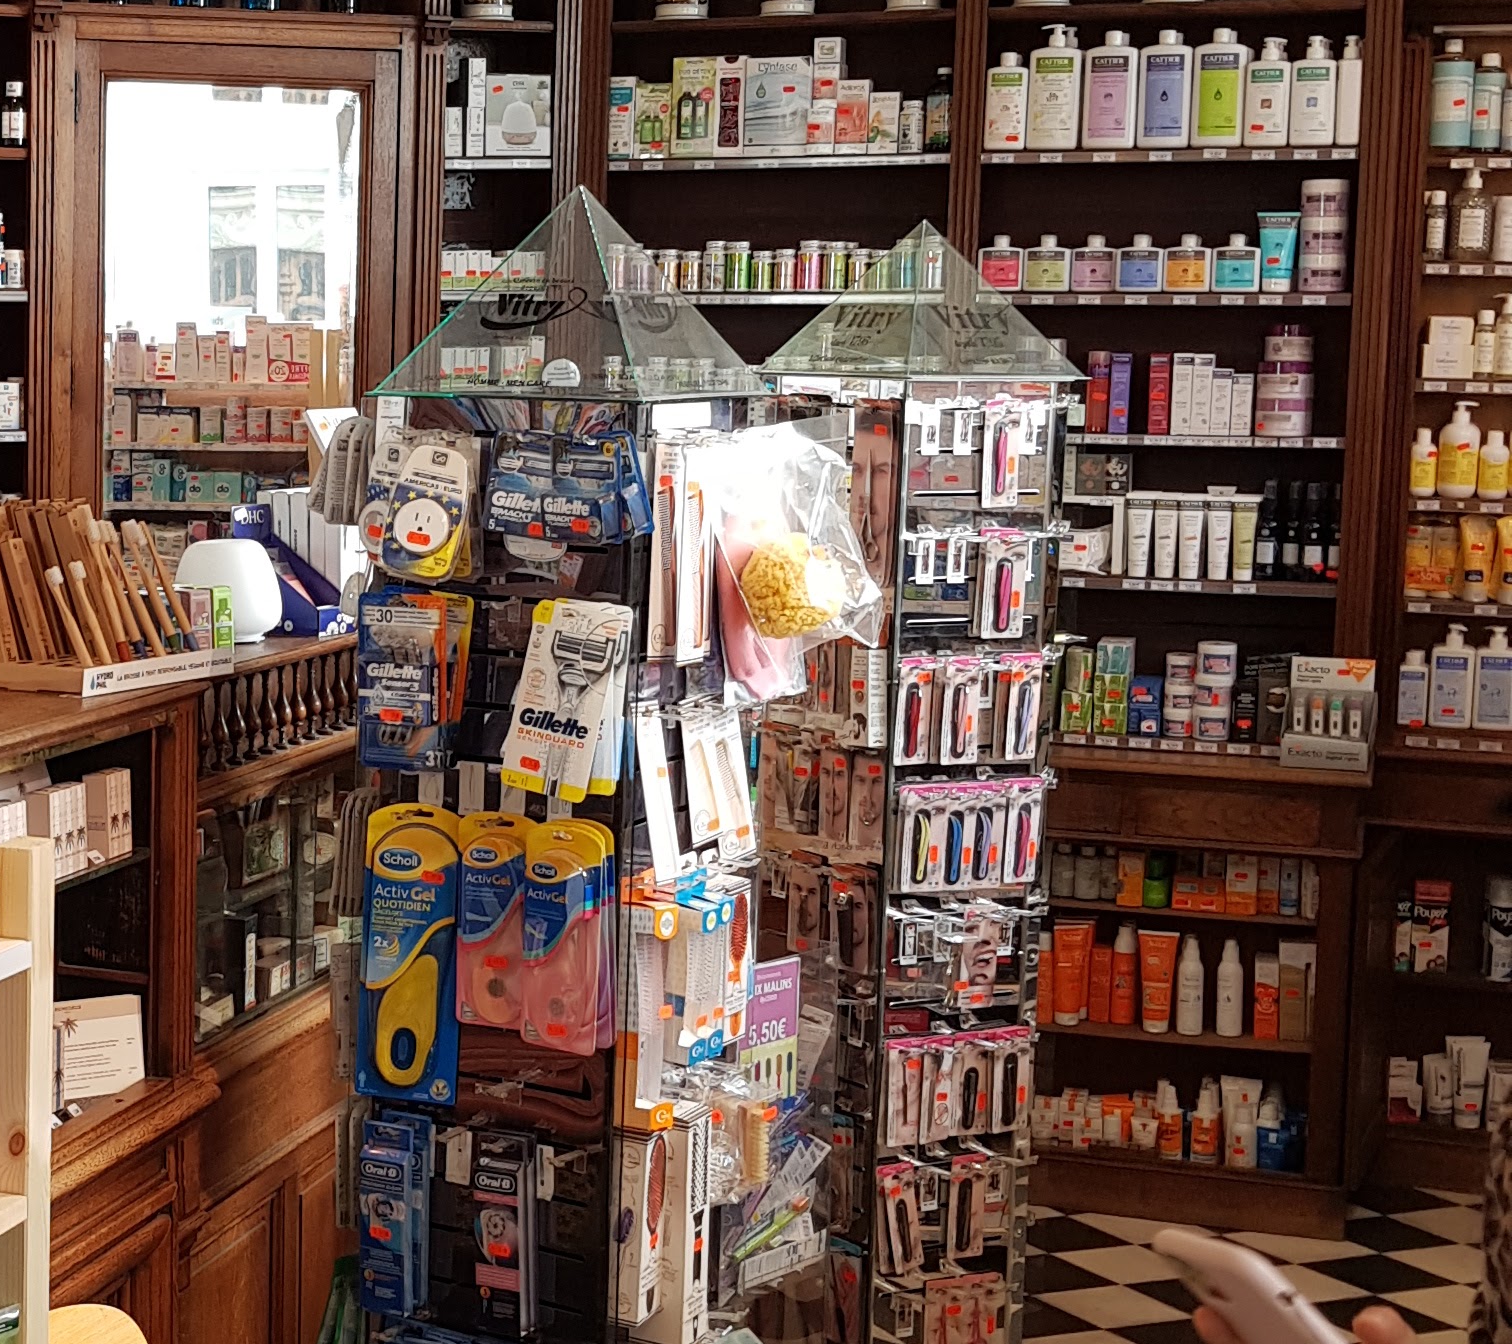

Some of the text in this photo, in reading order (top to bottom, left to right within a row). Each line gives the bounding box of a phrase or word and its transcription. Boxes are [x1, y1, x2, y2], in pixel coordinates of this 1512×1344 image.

[498, 293, 566, 322] Vitry
[542, 495, 591, 516] Gillette
[375, 608, 393, 624] 30
[366, 662, 423, 680] Gillette
[1296, 662, 1332, 675] Exacto
[519, 707, 590, 739] Gillette
[517, 727, 585, 750] SKINGUARD
[383, 852, 419, 867] Scholl
[471, 849, 497, 861] Scholl
[465, 872, 511, 886] Activ Gel
[373, 884, 437, 902] Activ Gel
[527, 888, 552, 902] Activ
[372, 899, 431, 912] QUOTIDIEN
[766, 975, 793, 995] MALINS
[748, 1015, 787, 1047] 5,50€
